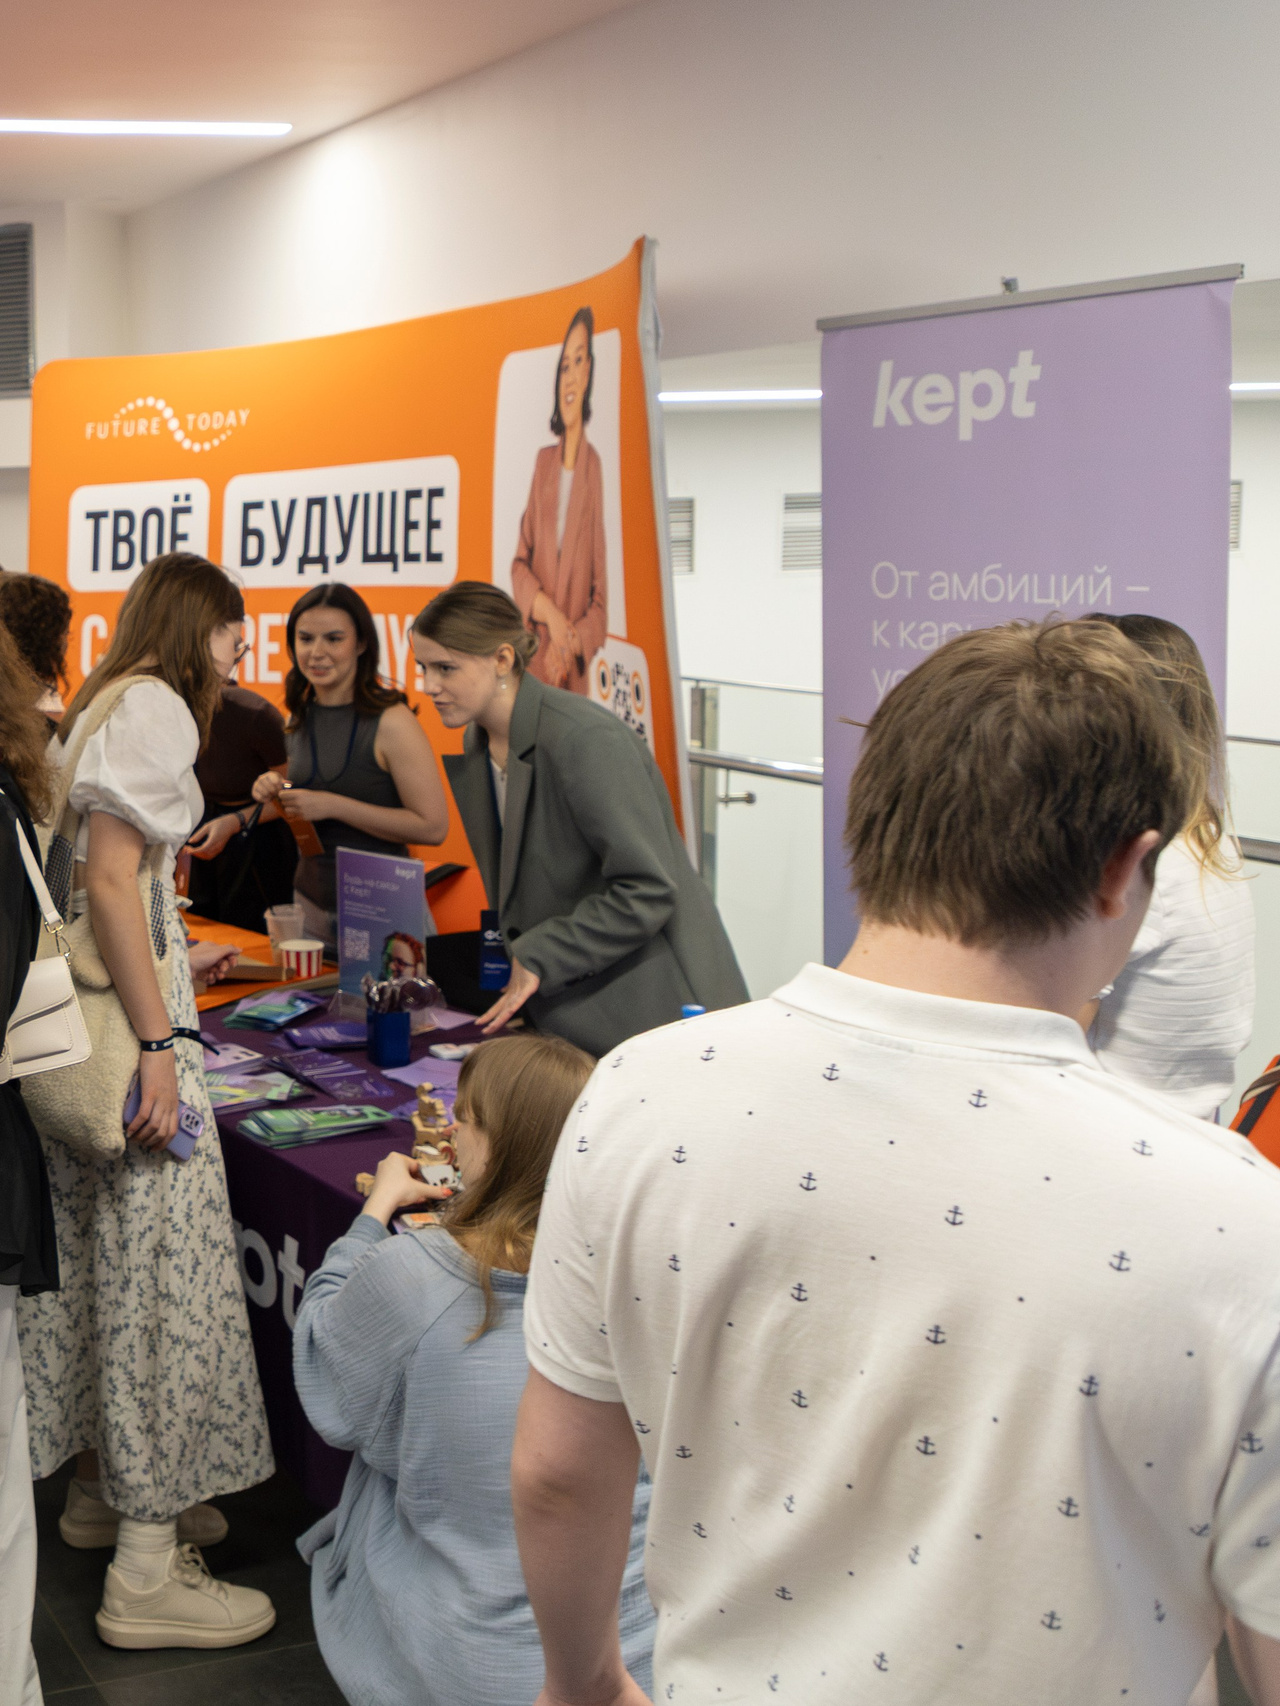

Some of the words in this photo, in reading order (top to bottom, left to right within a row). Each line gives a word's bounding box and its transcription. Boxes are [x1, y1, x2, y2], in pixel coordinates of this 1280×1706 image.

[872, 349, 1041, 441] kept
[85, 417, 161, 440] FUTURE
[186, 408, 250, 431] TODAY
[85, 494, 192, 572] ТВОЁ
[240, 487, 445, 574] БУДУЩЕЕ
[871, 561, 919, 599] От
[928, 563, 1112, 608] амбиций
[872, 619, 891, 648] к
